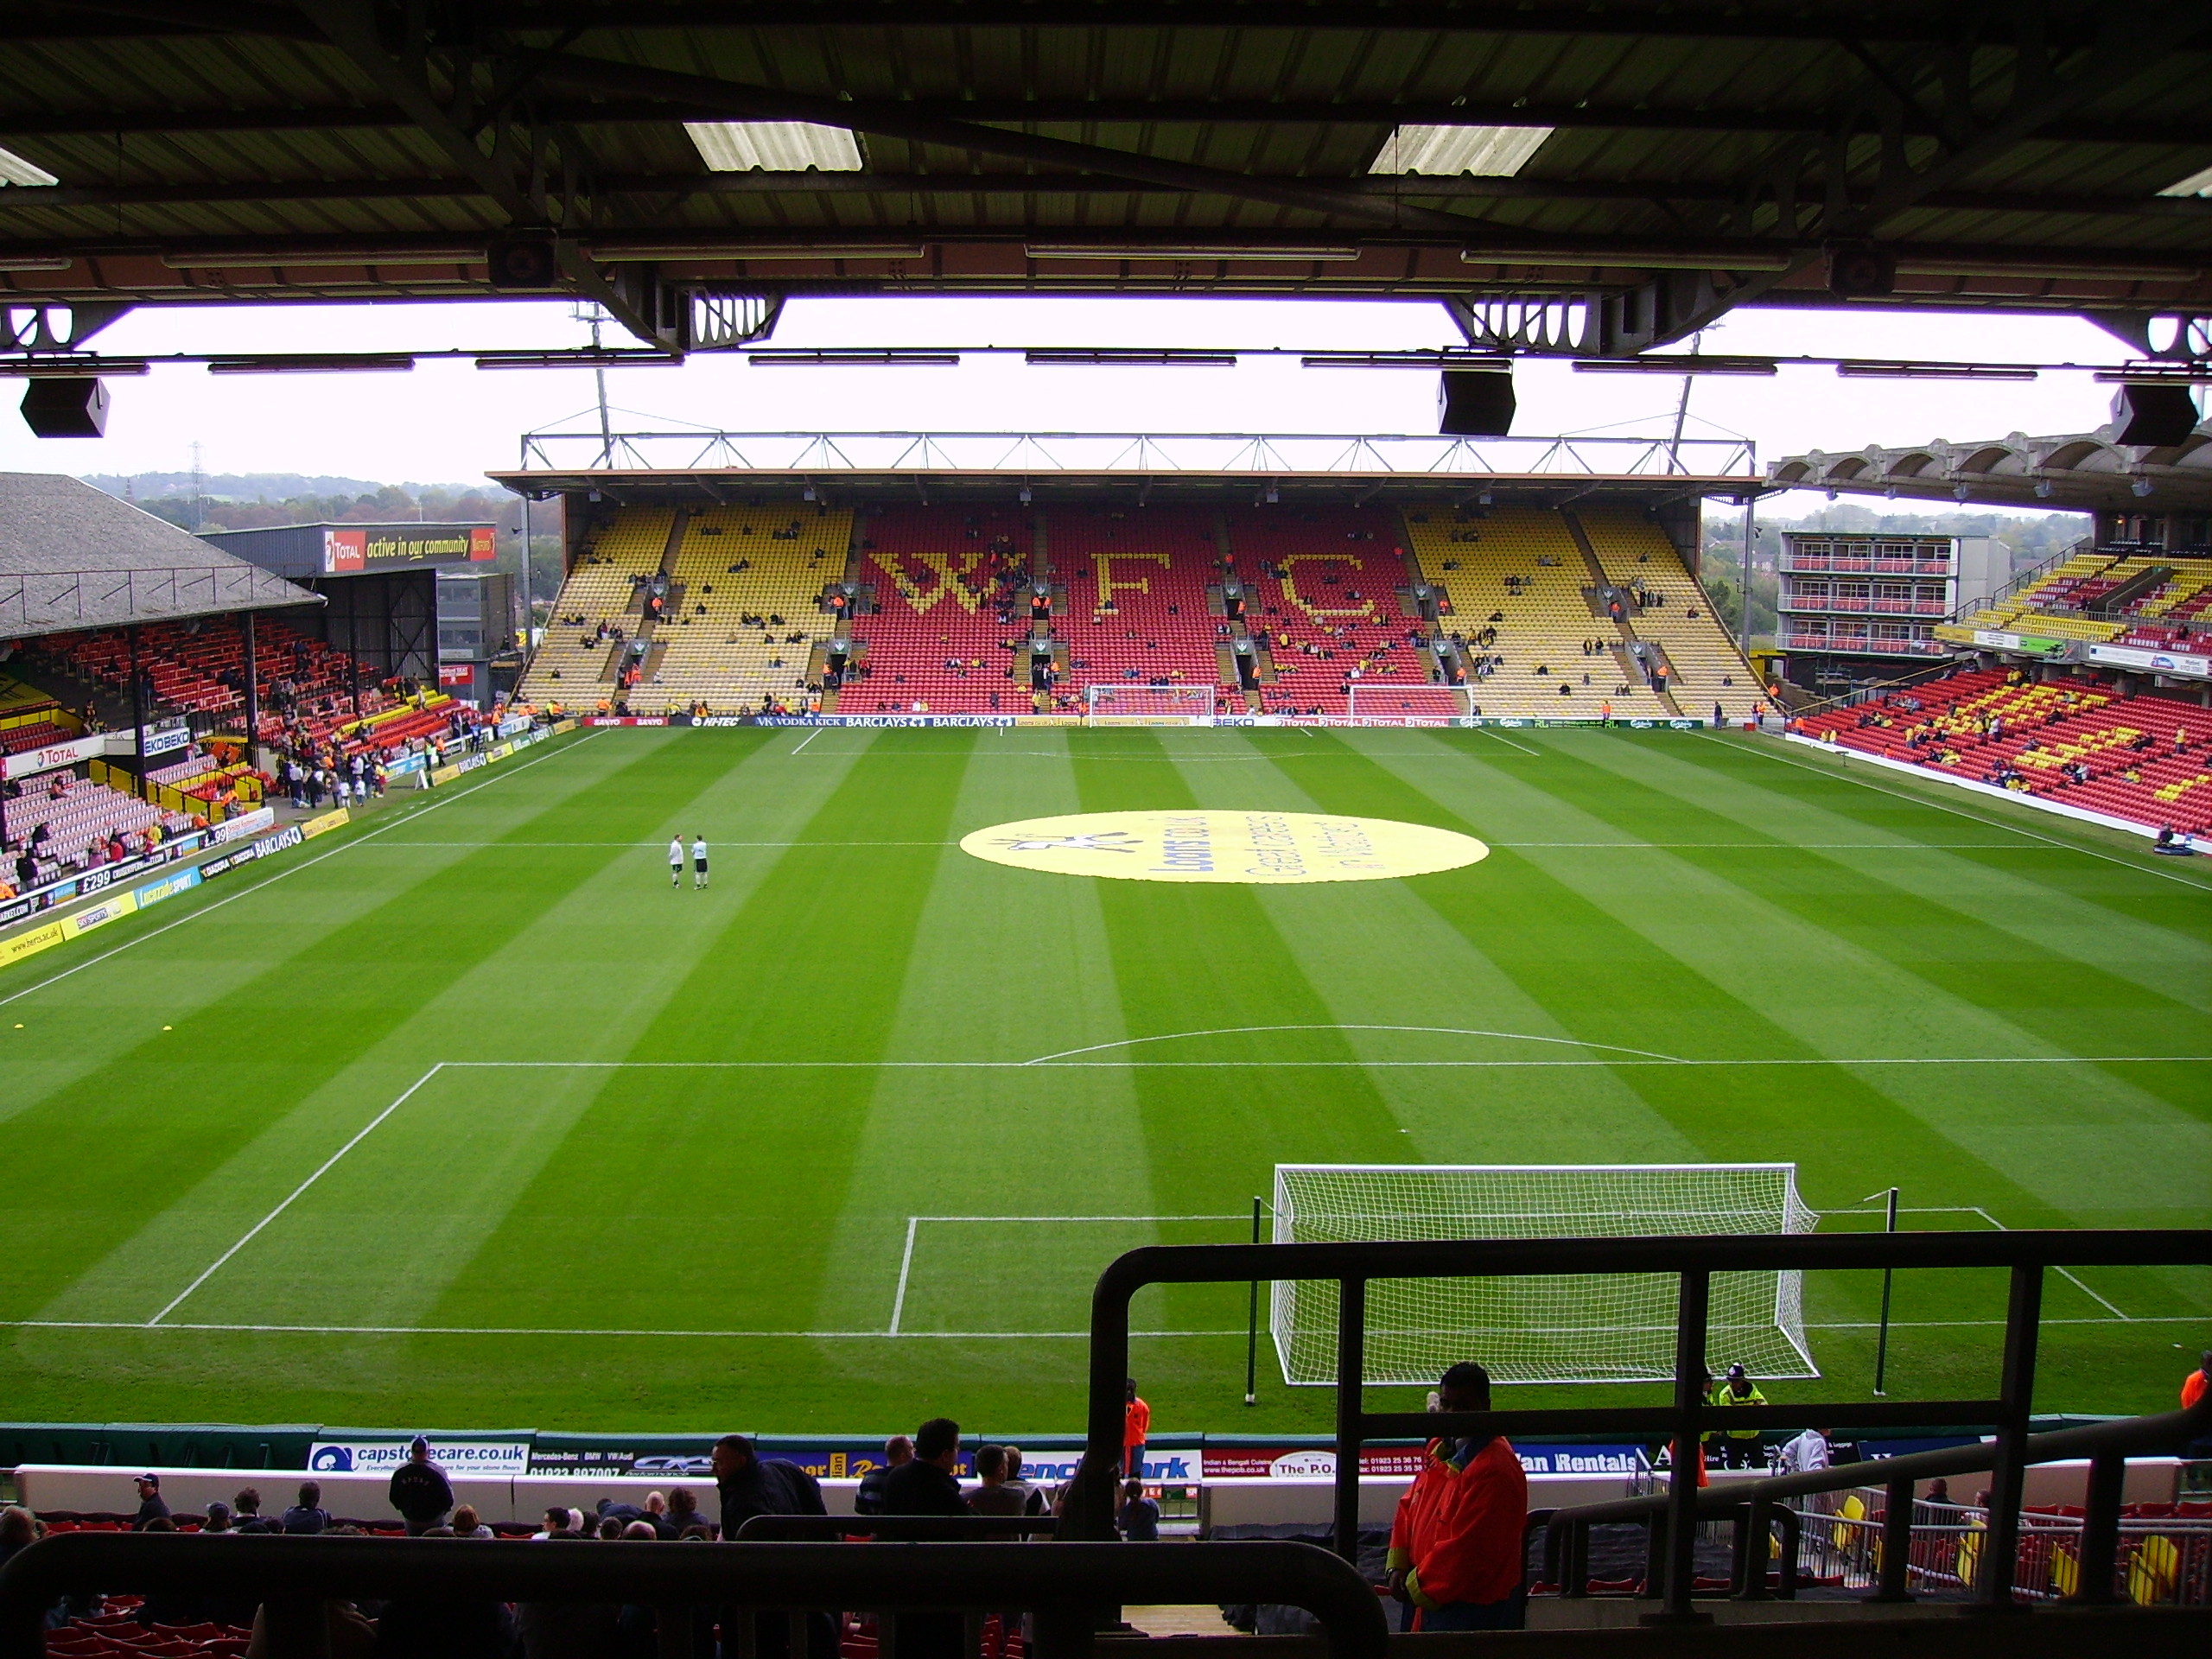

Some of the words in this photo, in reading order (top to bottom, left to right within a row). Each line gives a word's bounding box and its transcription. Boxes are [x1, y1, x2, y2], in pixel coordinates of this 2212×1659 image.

[334, 543, 360, 559] TOTAL
[367, 537, 395, 558] active
[398, 537, 406, 556] in
[410, 541, 423, 561] our
[424, 535, 468, 557] community
[703, 717, 739, 727] HI-TEC
[846, 718, 907, 728] BARCLAYS
[932, 718, 994, 728] BARCLAYS
[164, 731, 189, 748] BEKO
[46, 747, 79, 764] TOTAL
[255, 831, 293, 858] BARCLAYS
[82, 869, 111, 893] £299
[358, 1445, 524, 1464] capstoecare.co.uk
[531, 1452, 579, 1461] Mercedes-Benz
[584, 1452, 602, 1460] BMW
[1554, 1453, 1637, 1472] Rentals
[1279, 1464, 1305, 1474] The
